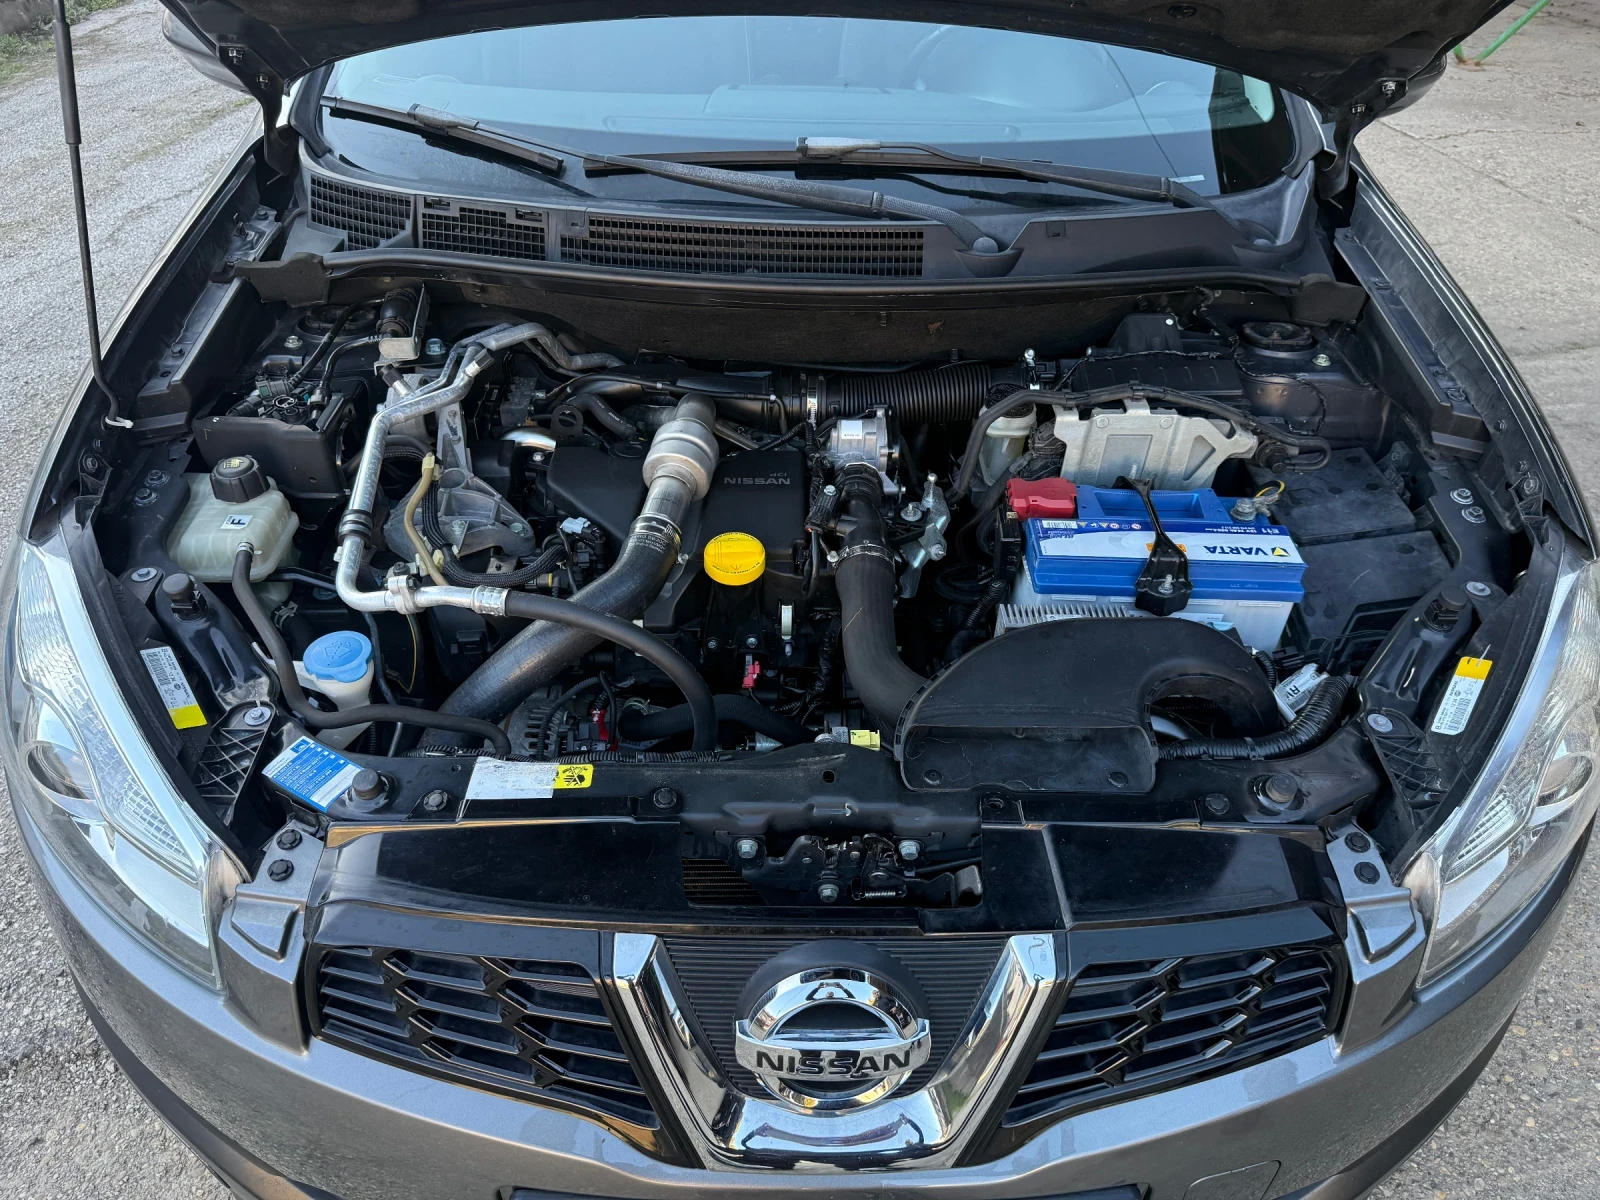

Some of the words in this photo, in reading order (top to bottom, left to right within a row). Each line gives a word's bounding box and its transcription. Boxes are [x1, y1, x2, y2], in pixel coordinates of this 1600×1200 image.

[724, 477, 790, 485] NISSAN
[1203, 545, 1269, 556] VARTA
[756, 1050, 911, 1075] NISSAN
